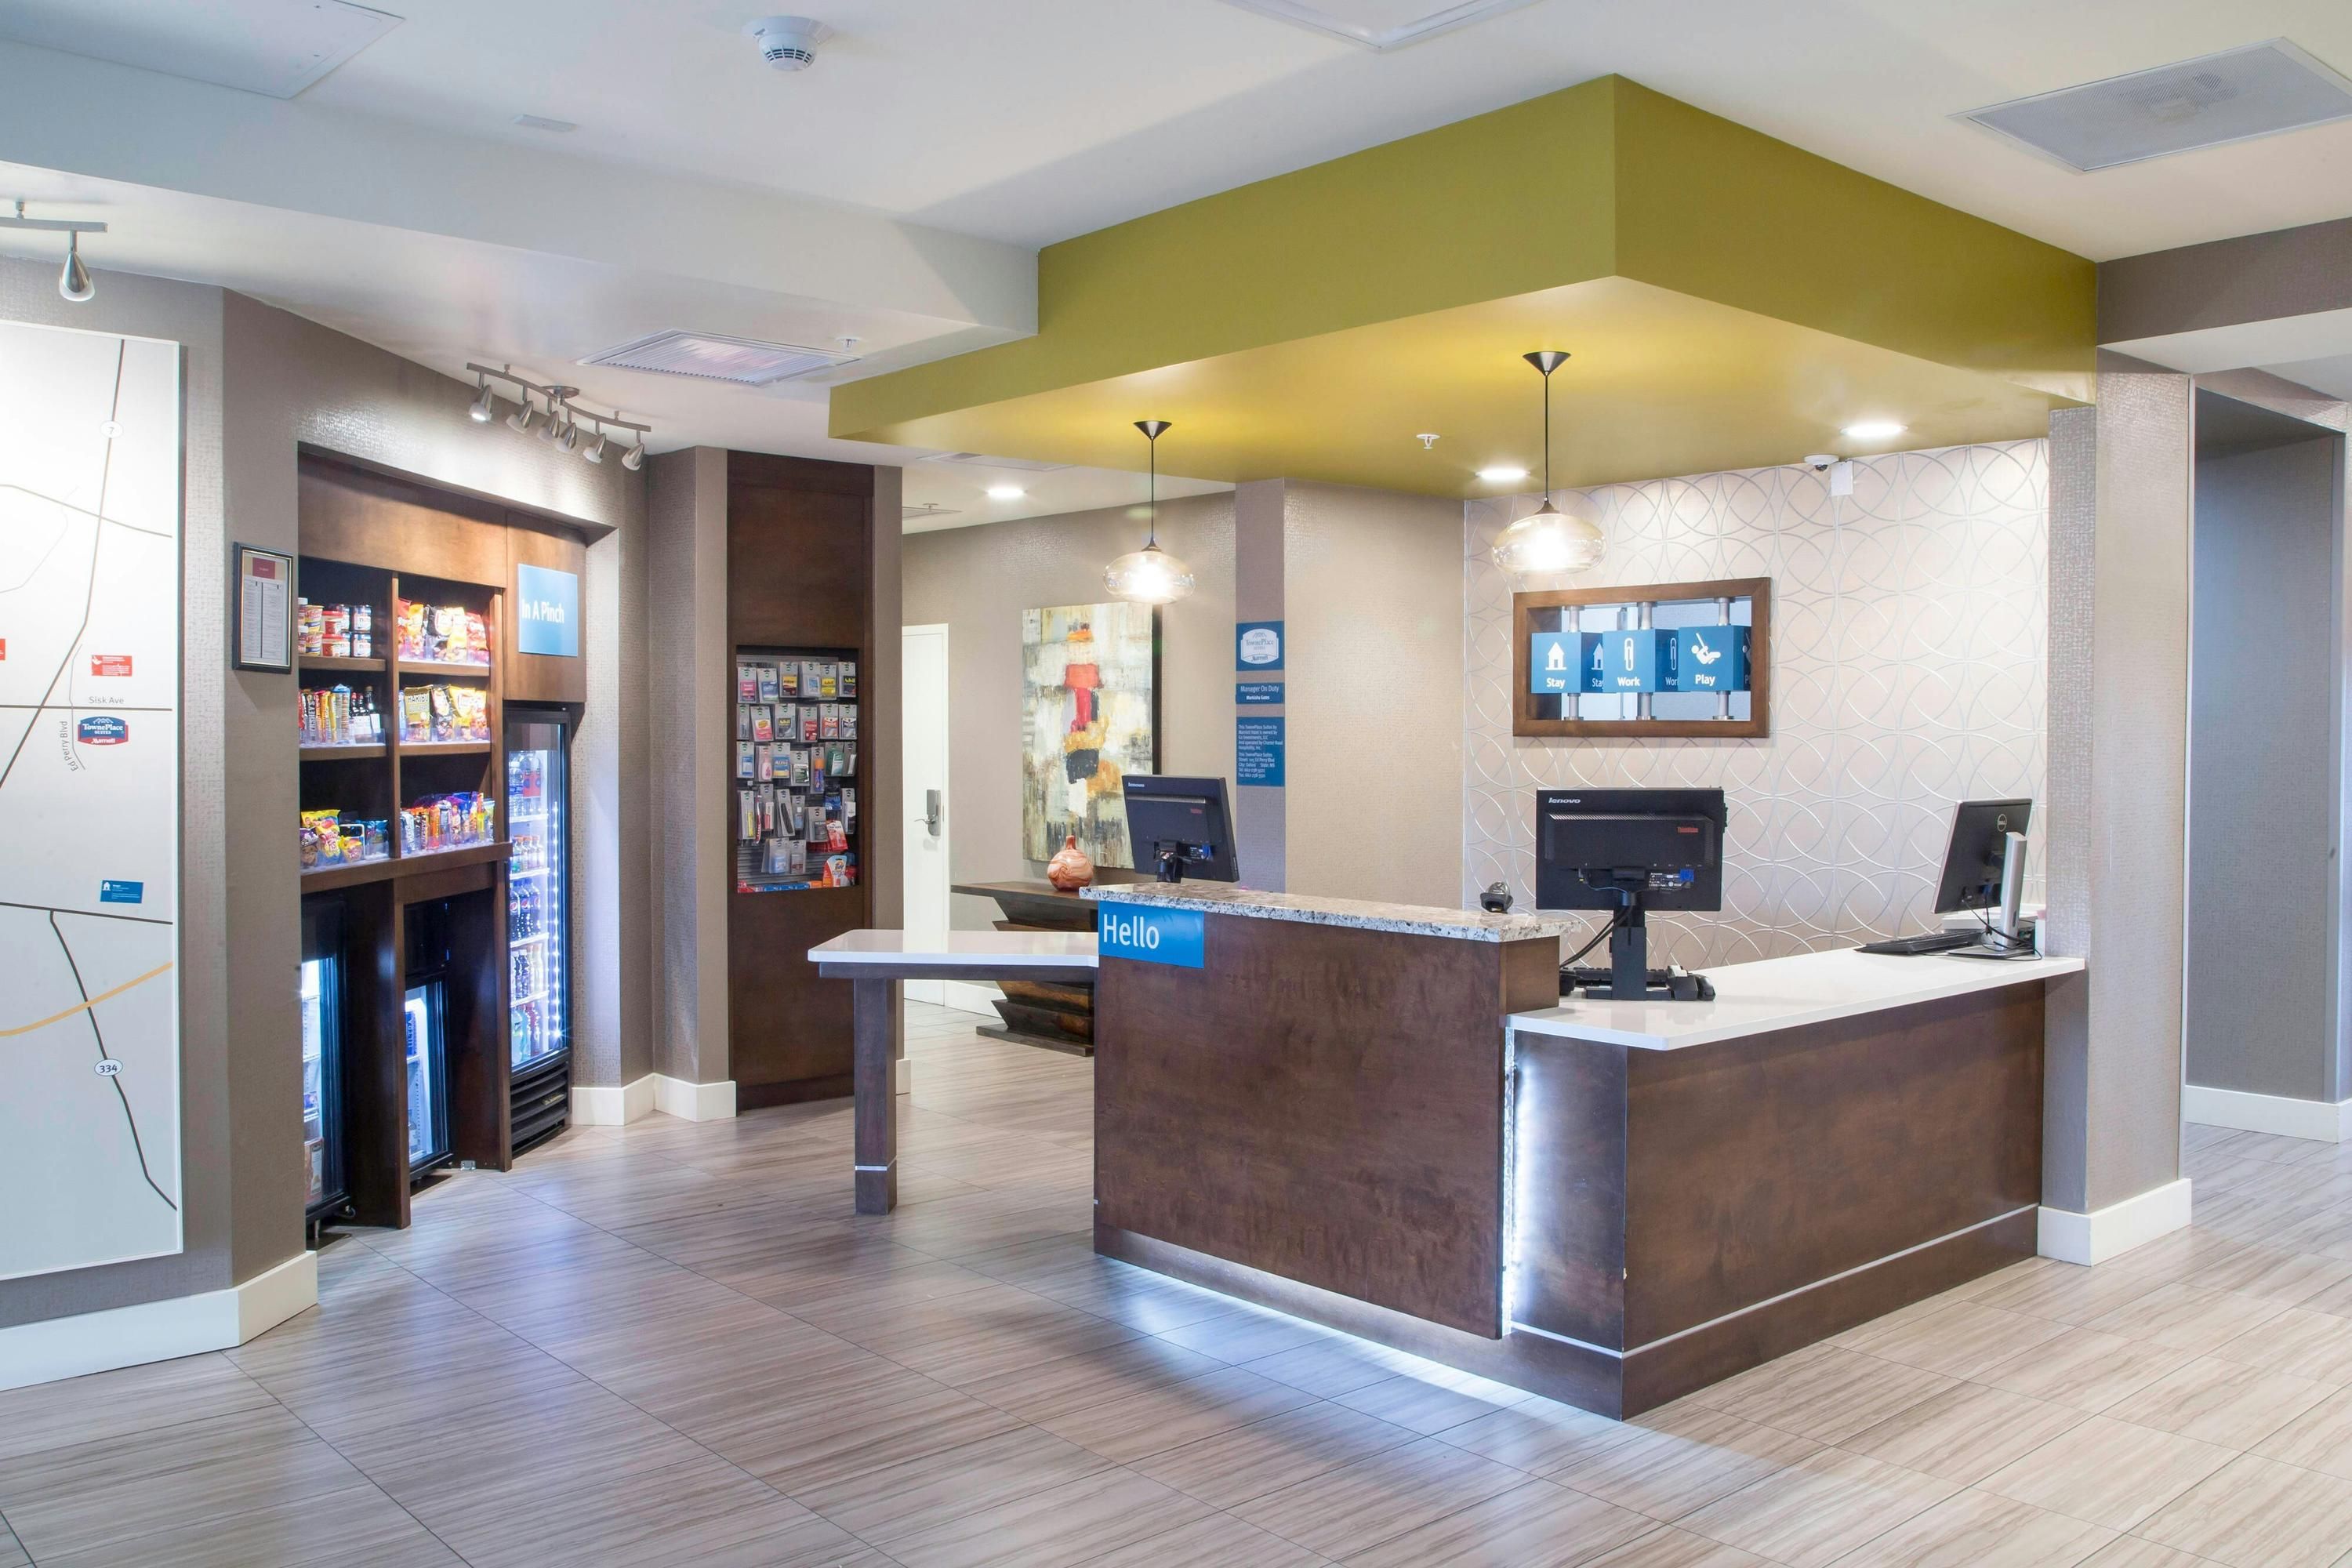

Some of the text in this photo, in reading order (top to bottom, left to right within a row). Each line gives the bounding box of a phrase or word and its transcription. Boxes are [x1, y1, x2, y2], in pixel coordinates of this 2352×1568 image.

[521, 598, 564, 624] In A Pinch
[1547, 677, 1565, 689] Stay
[1617, 677, 1641, 686] Work
[1695, 674, 1715, 686] Play
[60, 720, 68, 738] Blvd
[1103, 913, 1160, 949] Hello
[100, 1064, 118, 1074] 334
